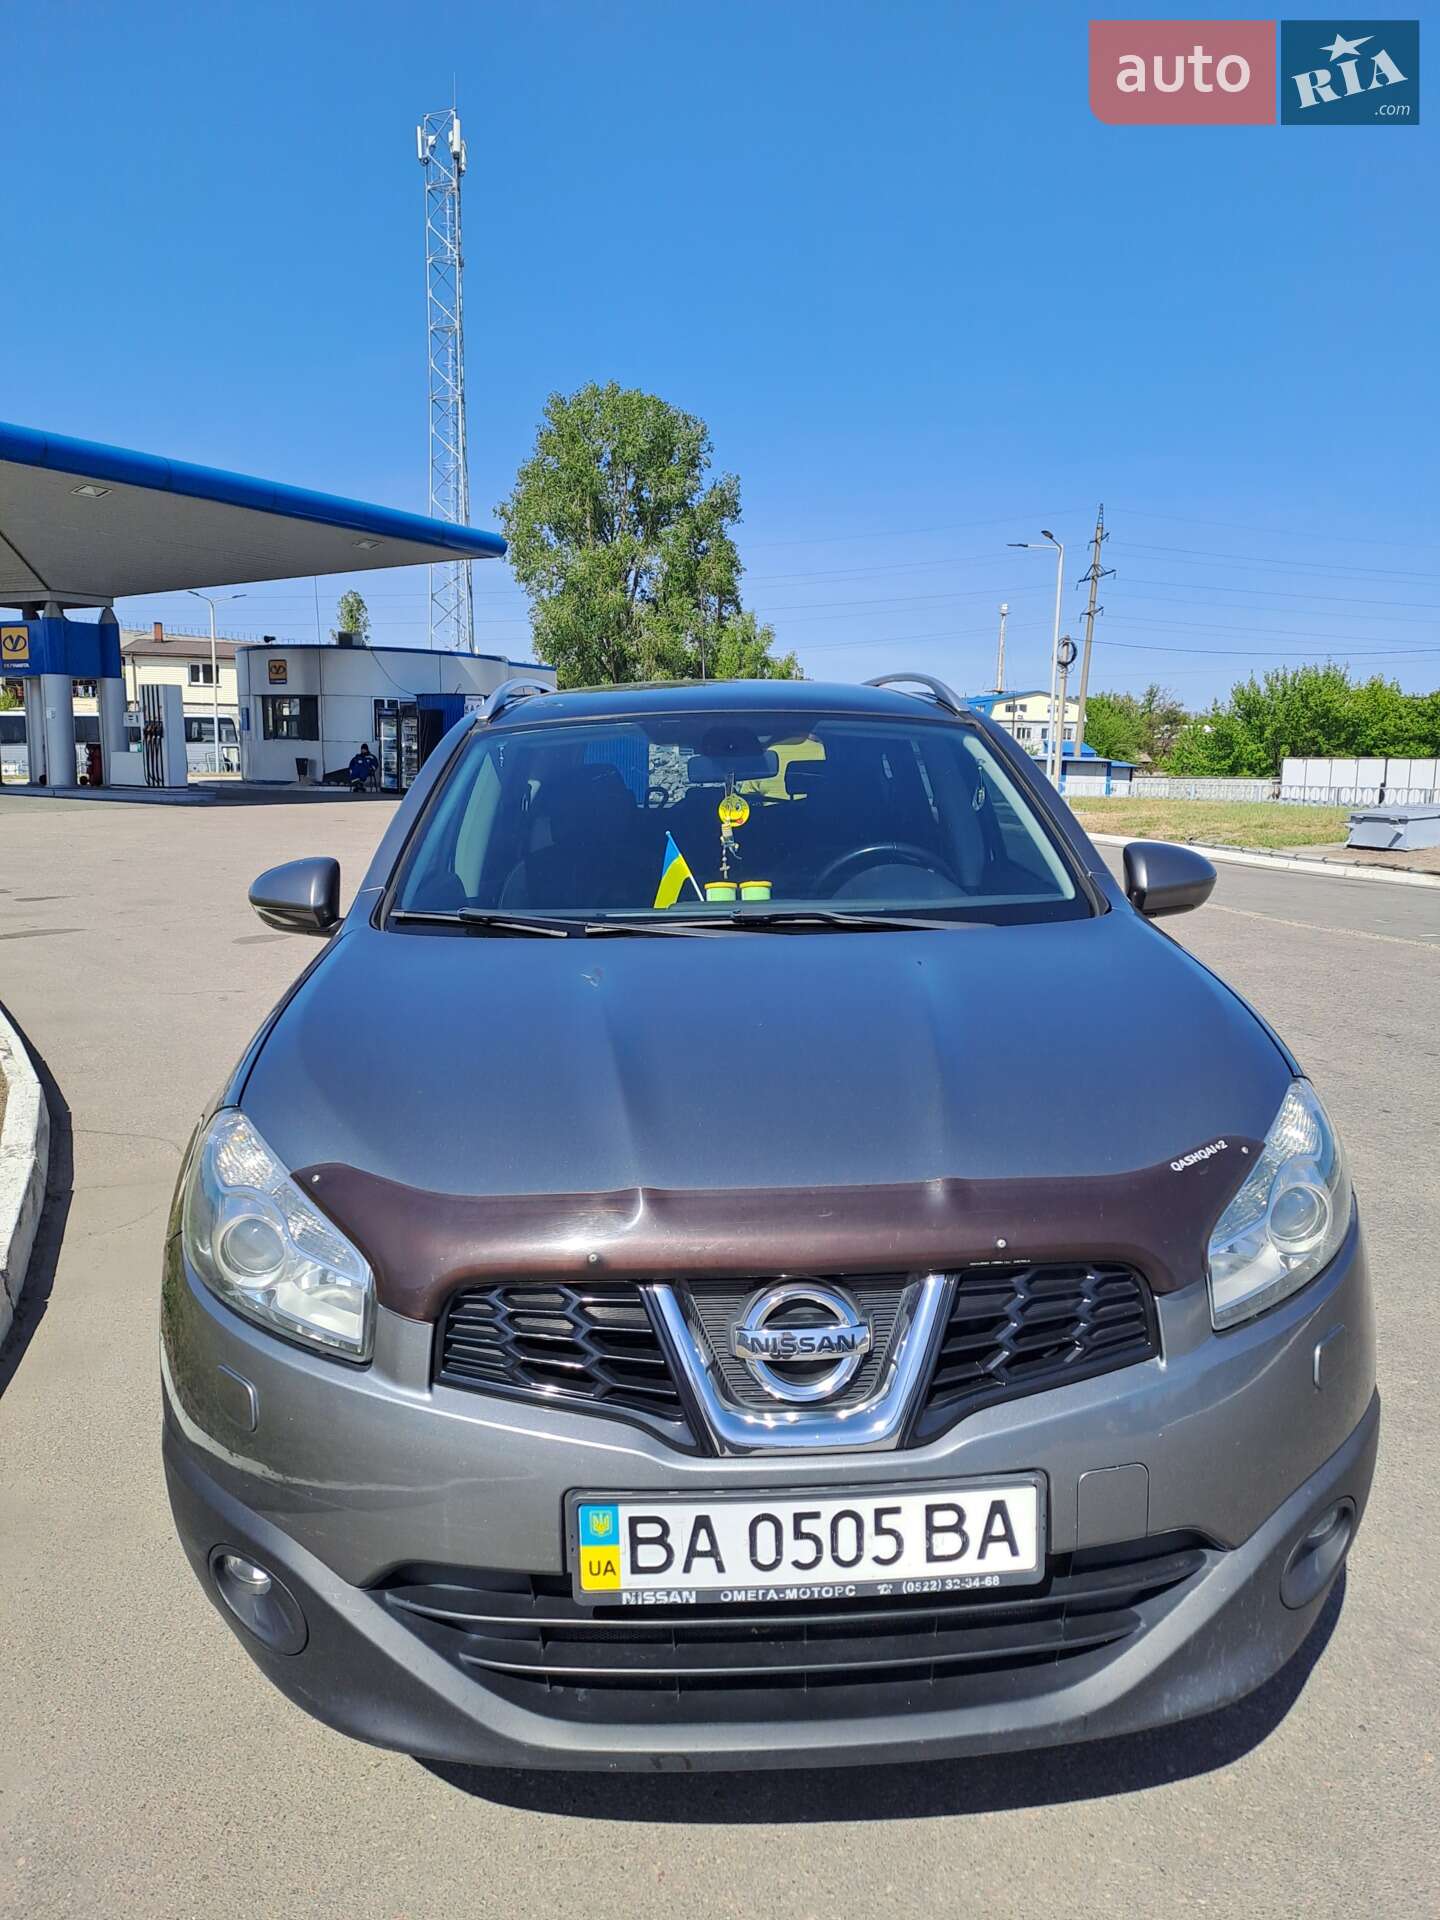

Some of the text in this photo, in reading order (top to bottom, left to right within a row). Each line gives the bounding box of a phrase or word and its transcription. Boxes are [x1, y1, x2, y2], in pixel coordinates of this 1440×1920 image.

[1170, 1140, 1228, 1172] QASHQAI+2
[750, 1334, 856, 1353] NISSAN
[628, 1499, 1020, 1575] BA 0505 BA
[589, 1560, 616, 1576] UA
[720, 1585, 856, 1602] ОМЕГА-МОТОРС
[902, 1575, 1001, 1594] (0522) 32-34-68
[622, 1590, 697, 1605] NISSAN
